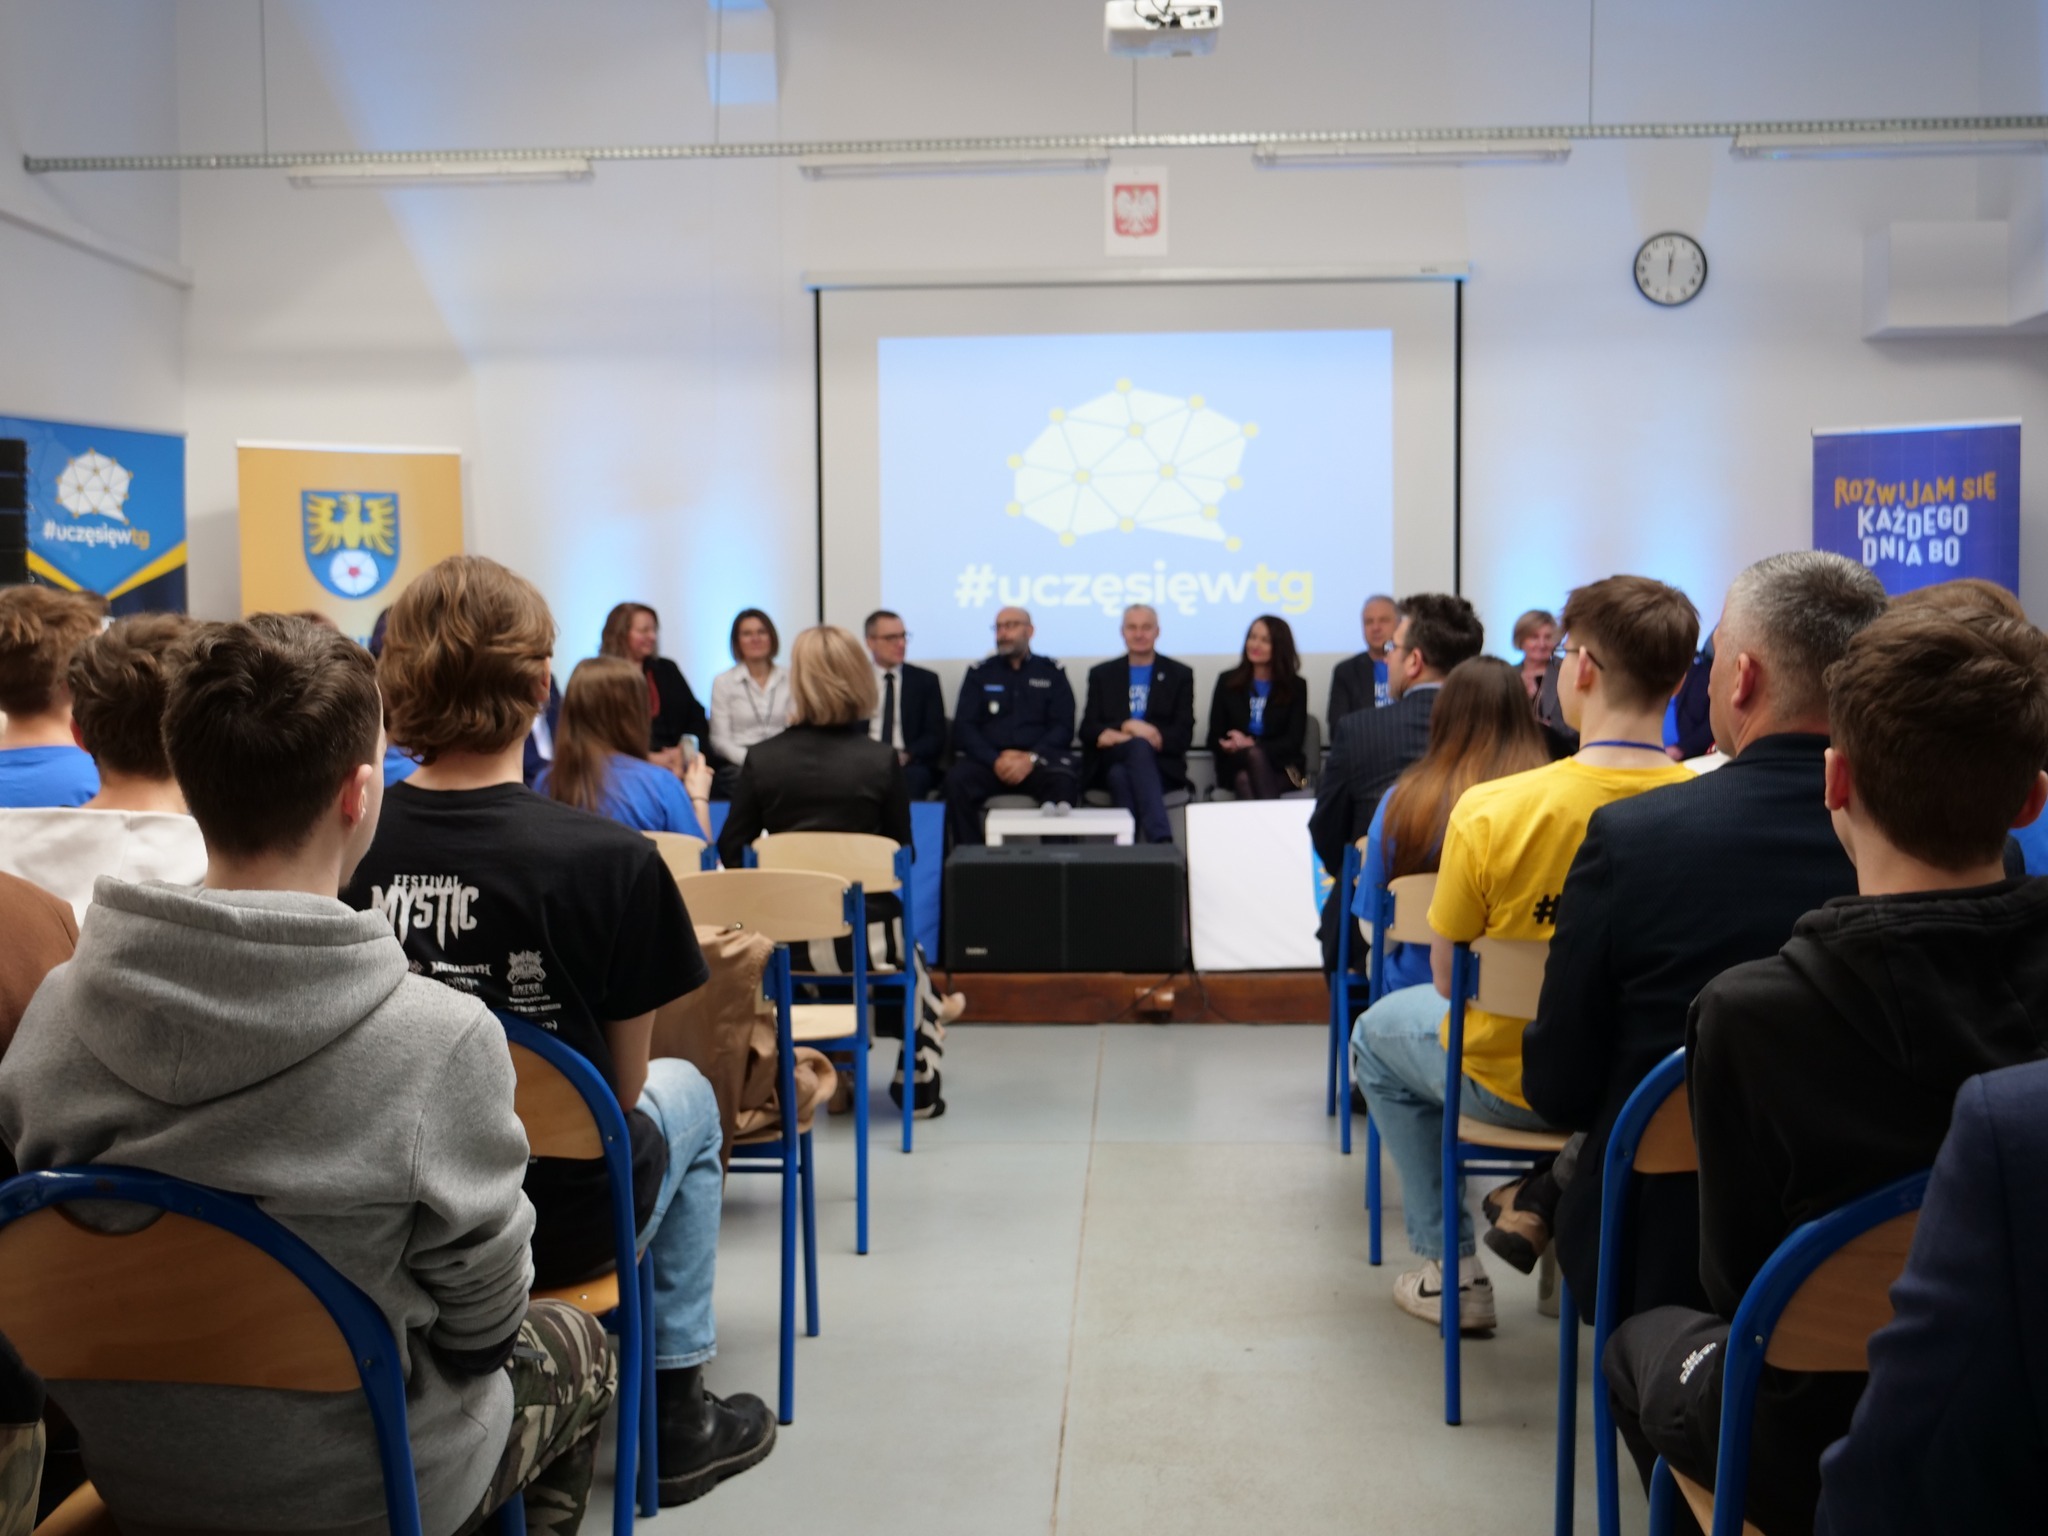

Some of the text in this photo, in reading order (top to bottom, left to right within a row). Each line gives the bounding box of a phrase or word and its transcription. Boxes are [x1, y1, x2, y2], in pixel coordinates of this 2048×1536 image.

[1834, 471, 1996, 508] ROZWIJAM SIĘ
[44, 520, 149, 550] #uczęsięwtg
[1858, 504, 1968, 540] KAŻDEGO
[1862, 535, 1960, 567] DNIA BO
[954, 559, 1314, 617] #uczęsięwtg
[394, 874, 462, 889] FESTIVAL
[371, 884, 479, 950] MYSTIC
[430, 961, 492, 976] MEGADETH
